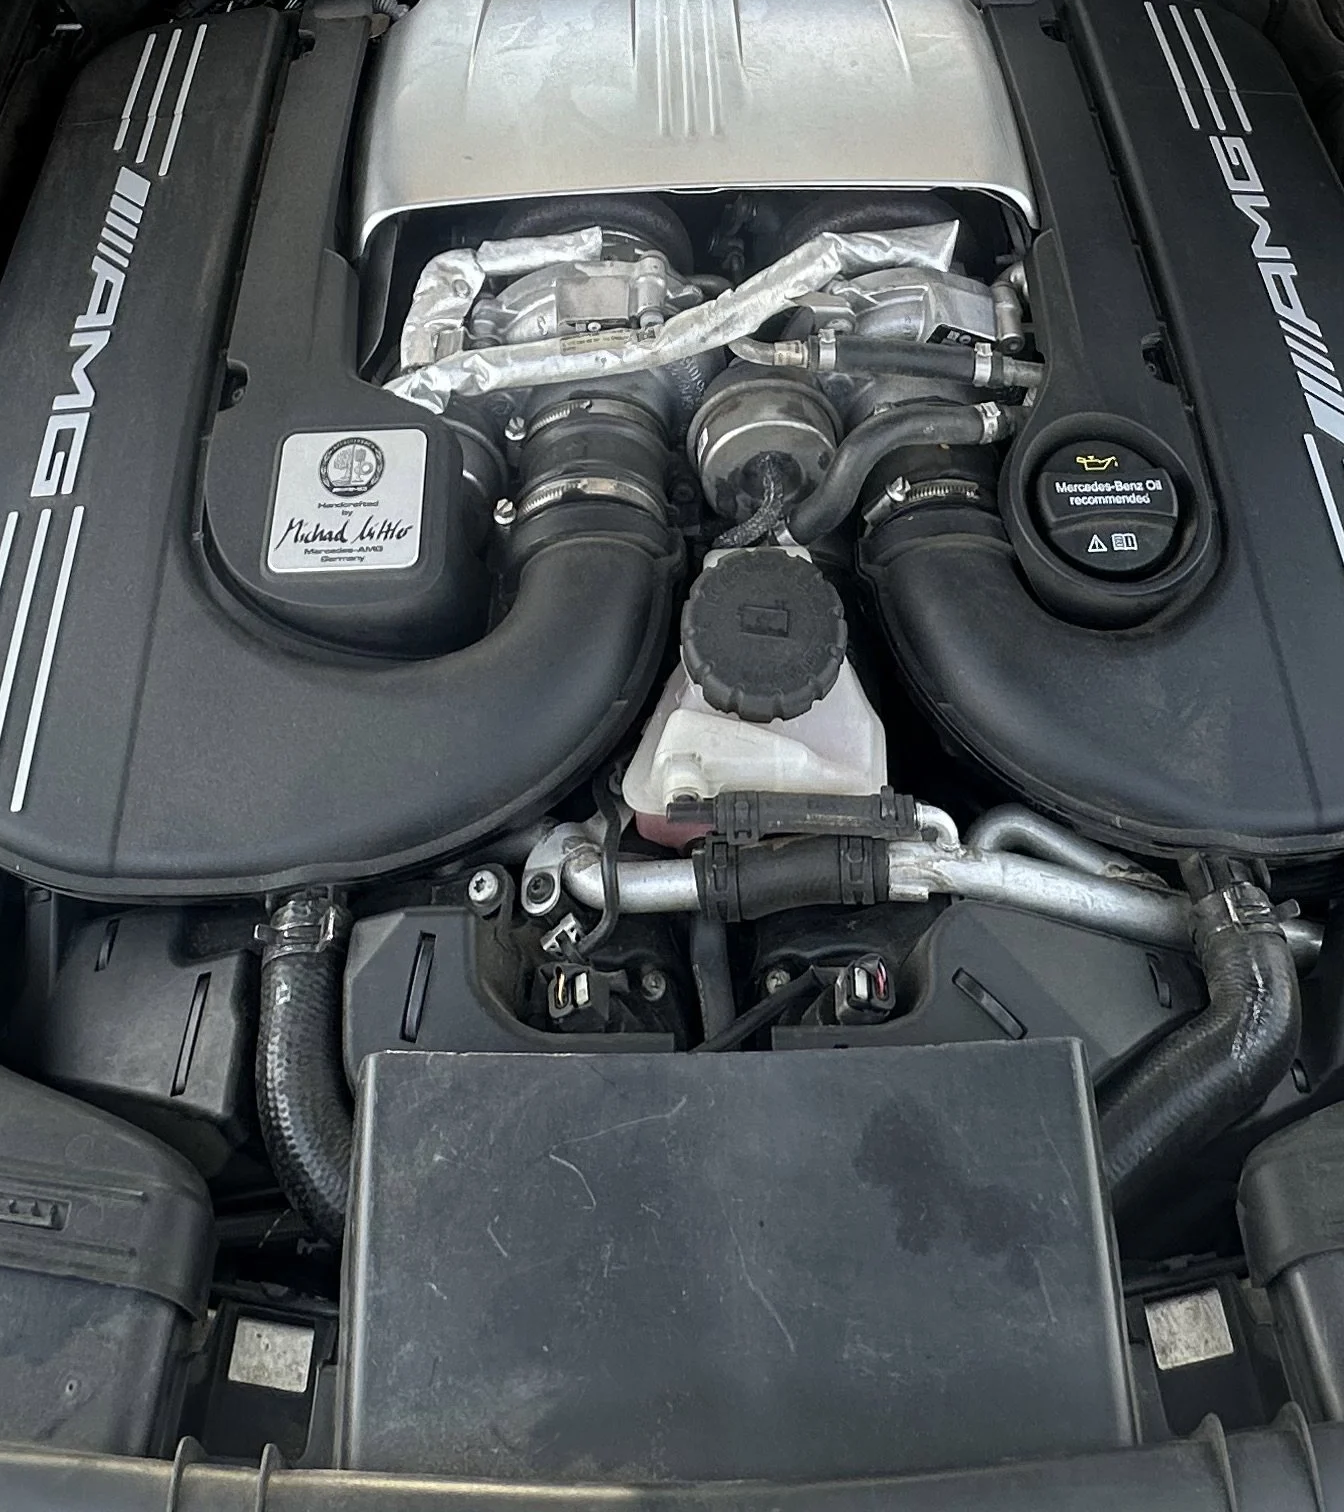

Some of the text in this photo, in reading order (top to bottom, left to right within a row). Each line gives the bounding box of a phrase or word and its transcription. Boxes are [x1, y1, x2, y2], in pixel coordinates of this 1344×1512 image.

[1209, 134, 1324, 337] AMG
[29, 261, 127, 499] AMG
[1055, 479, 1163, 494] Mercedes-Benz Oil
[317, 500, 380, 509] Handcrafted
[1069, 493, 1151, 506] recommended
[341, 509, 354, 517] by
[303, 545, 384, 555] Mercedes-AMG
[320, 555, 365, 564] Germany
